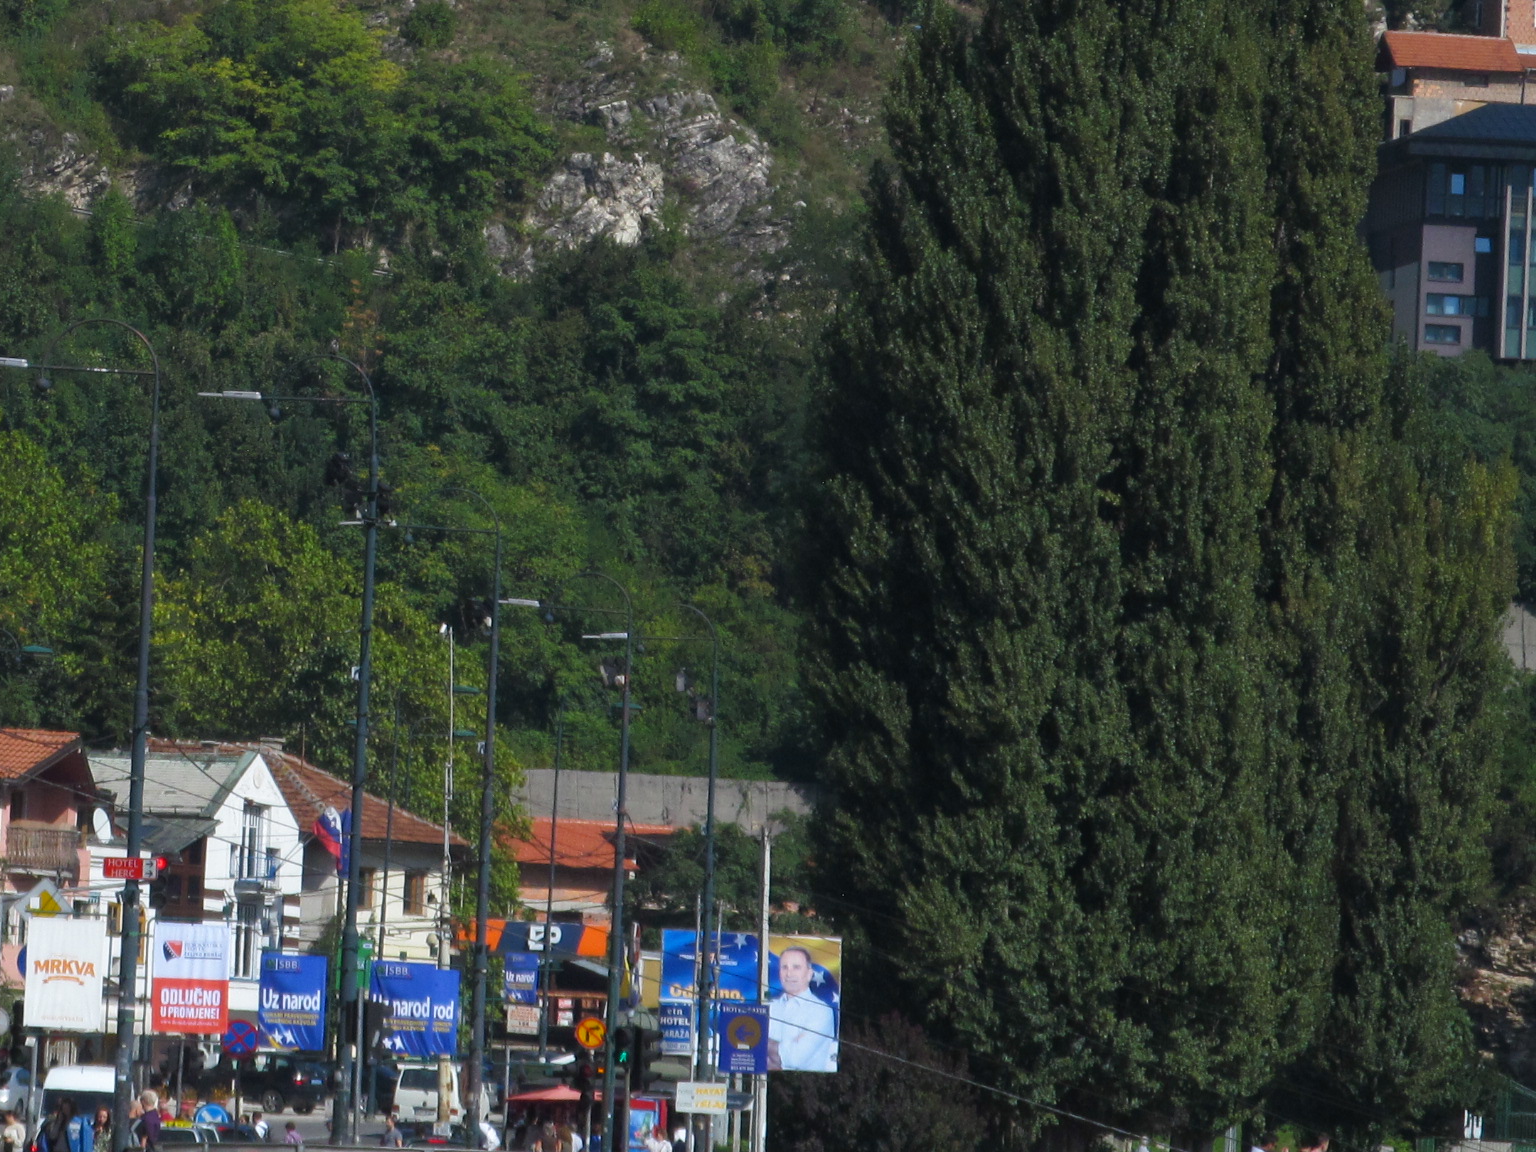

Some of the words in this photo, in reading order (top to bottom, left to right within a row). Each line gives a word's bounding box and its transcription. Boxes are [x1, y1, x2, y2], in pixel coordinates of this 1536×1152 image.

[108, 858, 138, 868] HOTEL
[34, 959, 96, 977] MRKVA
[279, 960, 298, 969] SBB
[389, 966, 408, 976] SBB
[506, 971, 515, 982] Uz
[516, 971, 535, 983] narod
[160, 987, 221, 1006] ODLUČNO
[670, 984, 745, 1001] Odno,
[263, 988, 279, 1009] Uz
[283, 990, 321, 1011] narod
[160, 1006, 166, 1018] U
[167, 1006, 220, 1019] PROMJENE!
[393, 996, 431, 1018] narod
[433, 1000, 454, 1020] rod
[660, 1016, 690, 1026] HOTEL
[662, 1028, 690, 1039] ARAŽA
